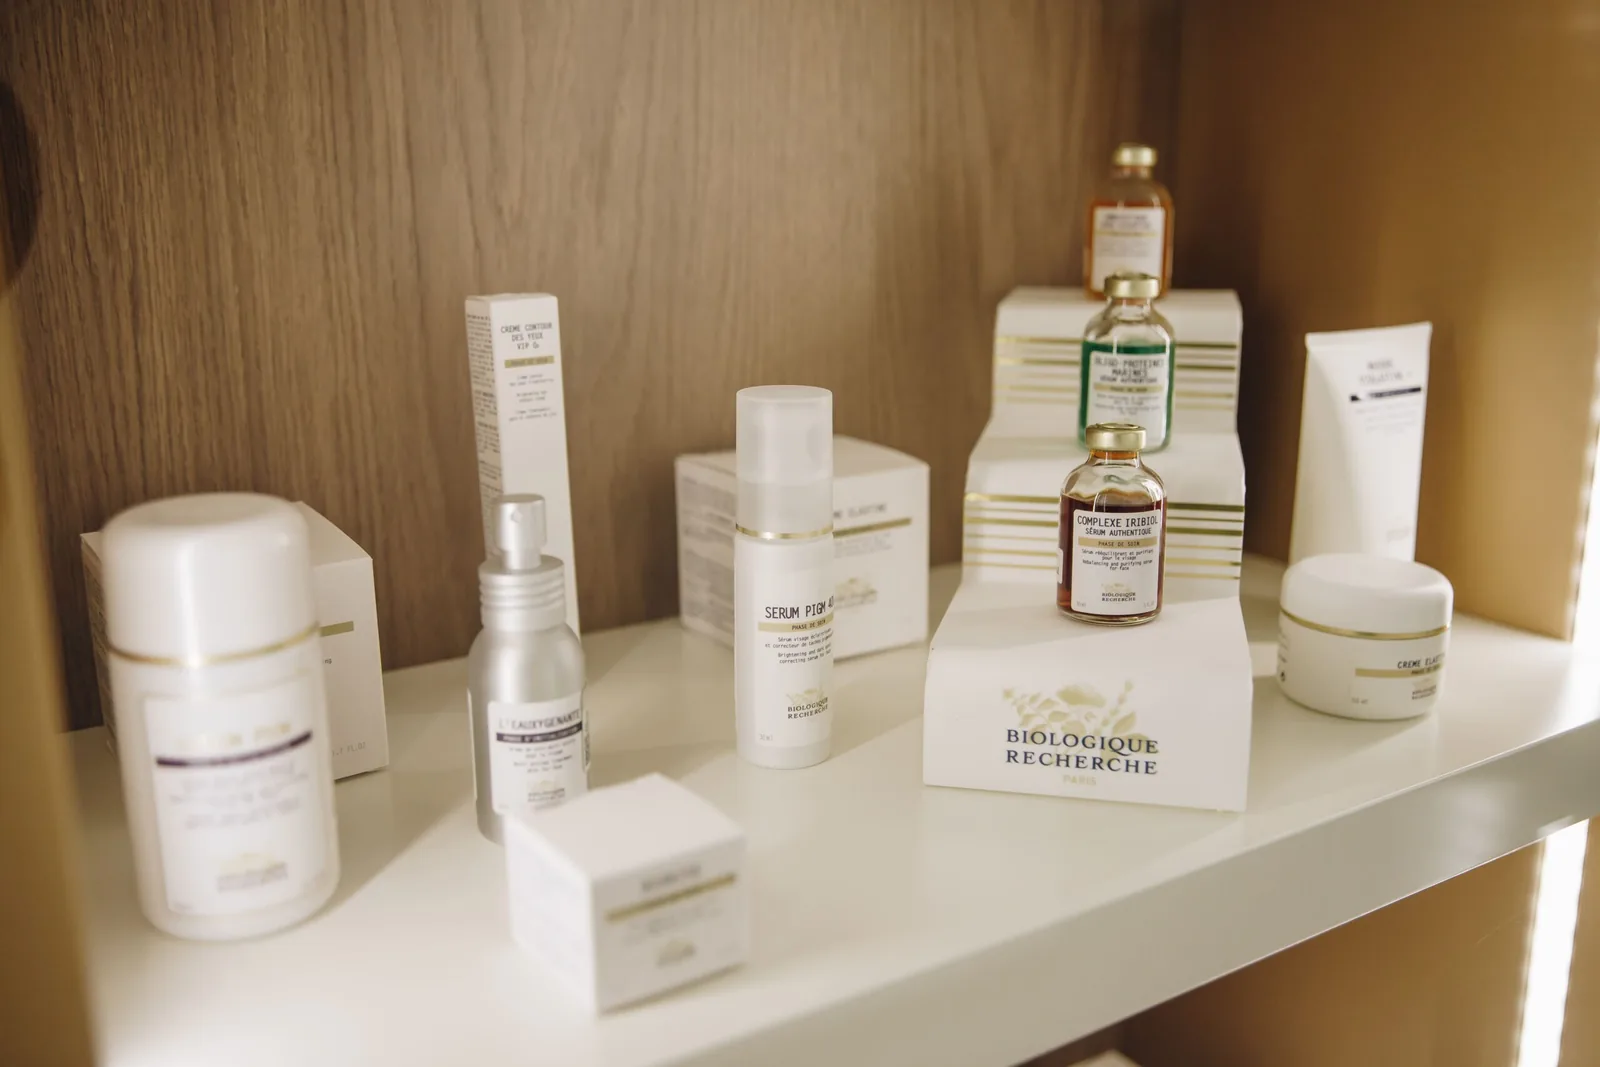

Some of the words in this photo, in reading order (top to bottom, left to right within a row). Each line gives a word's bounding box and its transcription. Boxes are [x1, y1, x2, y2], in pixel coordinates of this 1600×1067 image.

[524, 322, 552, 332] CONTOUR
[512, 334, 524, 342] DES
[527, 332, 544, 340] YEUX
[1077, 515, 1122, 527] COMPLEXE
[1126, 516, 1158, 527] IRIBIOL
[1085, 527, 1106, 536] SÉRUM
[1109, 528, 1151, 536] AUTHENTIQUE
[765, 606, 800, 619] SERUM
[805, 601, 826, 617] PIGM
[791, 623, 807, 631] PHASE
[809, 621, 816, 629] DE
[778, 651, 807, 659] Brightening
[808, 648, 816, 656] and
[1397, 660, 1421, 669] CREME
[787, 697, 828, 712] BIOLOGIQUE
[787, 704, 828, 719] RECHERCHE
[1006, 728, 1159, 756] BIOLOGIQUE
[1006, 750, 1158, 775] RECHERCHE
[1062, 774, 1097, 786] PARIS
